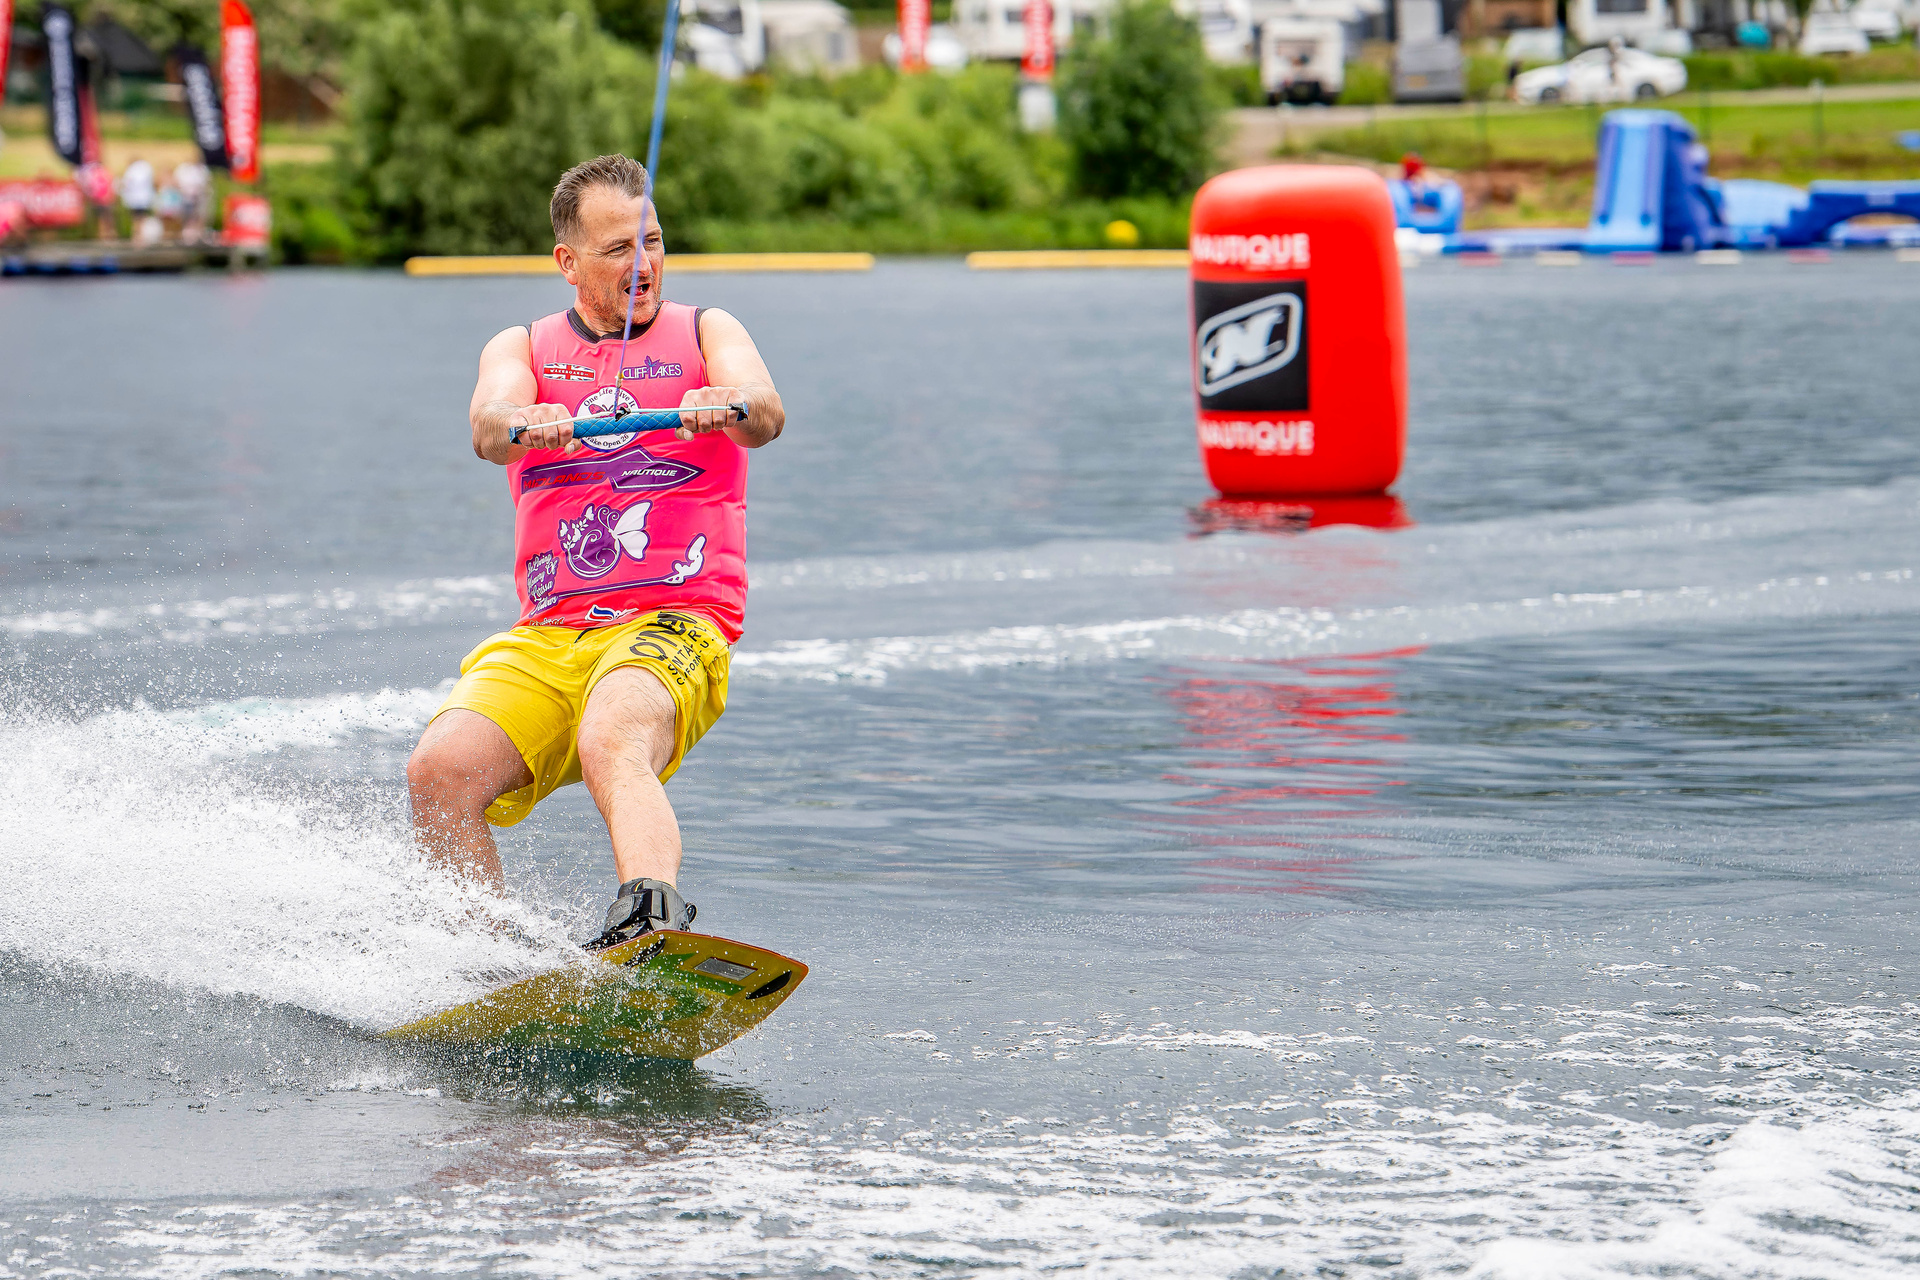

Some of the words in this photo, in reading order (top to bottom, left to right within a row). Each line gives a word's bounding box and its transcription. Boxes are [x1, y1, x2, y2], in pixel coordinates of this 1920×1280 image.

[623, 366, 648, 379] CLIFF
[649, 364, 682, 378] LAKES
[583, 395, 599, 407] One
[614, 389, 630, 402] ive
[602, 440, 621, 448] Open
[523, 471, 606, 489] MIDLANDS
[621, 469, 678, 477] NAUTIQUE
